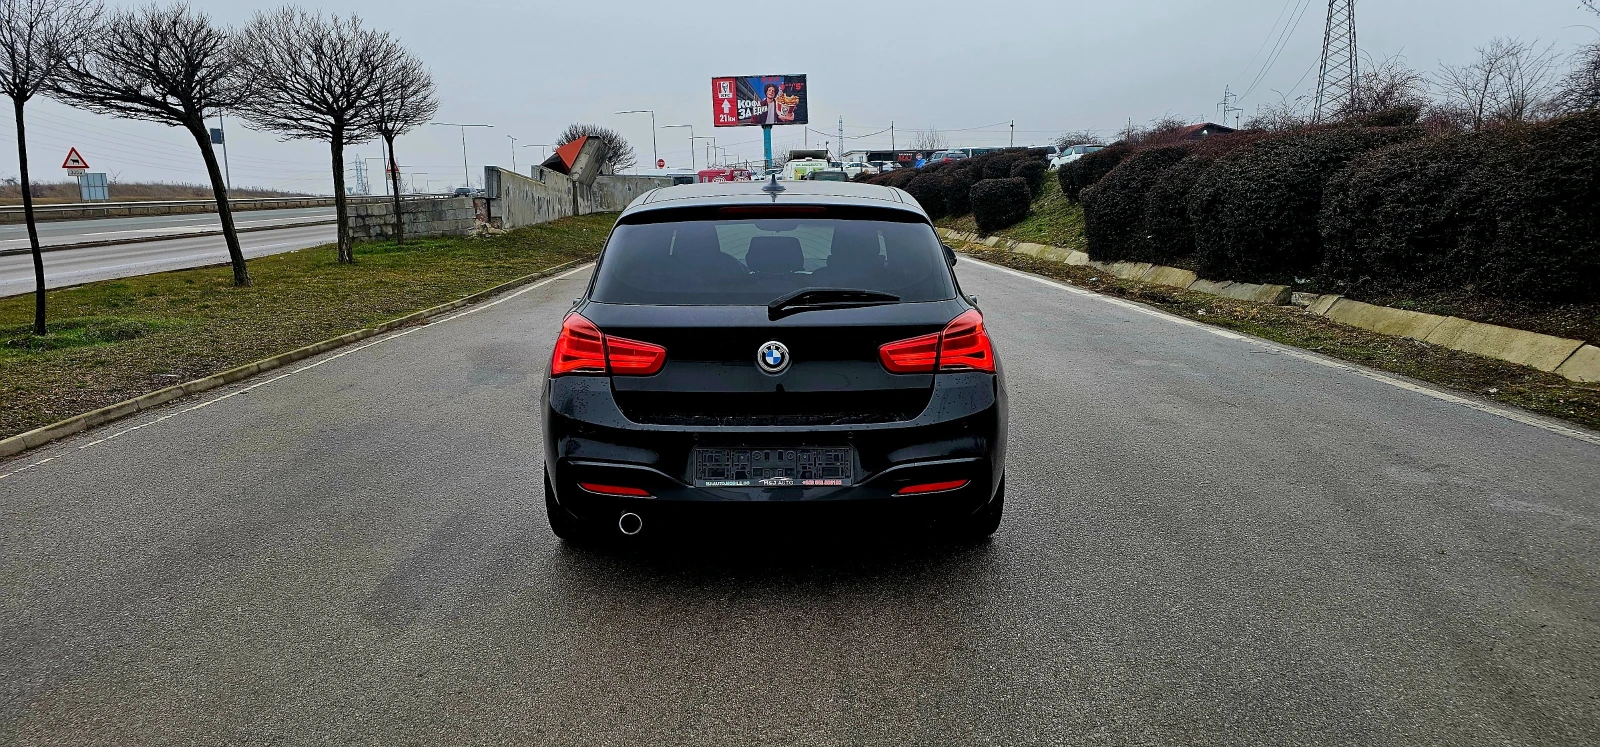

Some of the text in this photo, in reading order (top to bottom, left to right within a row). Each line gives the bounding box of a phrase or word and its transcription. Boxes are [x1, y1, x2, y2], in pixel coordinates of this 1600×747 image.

[738, 100, 761, 109] КОФА
[720, 114, 727, 122] 21
[738, 108, 751, 119] ЗА
